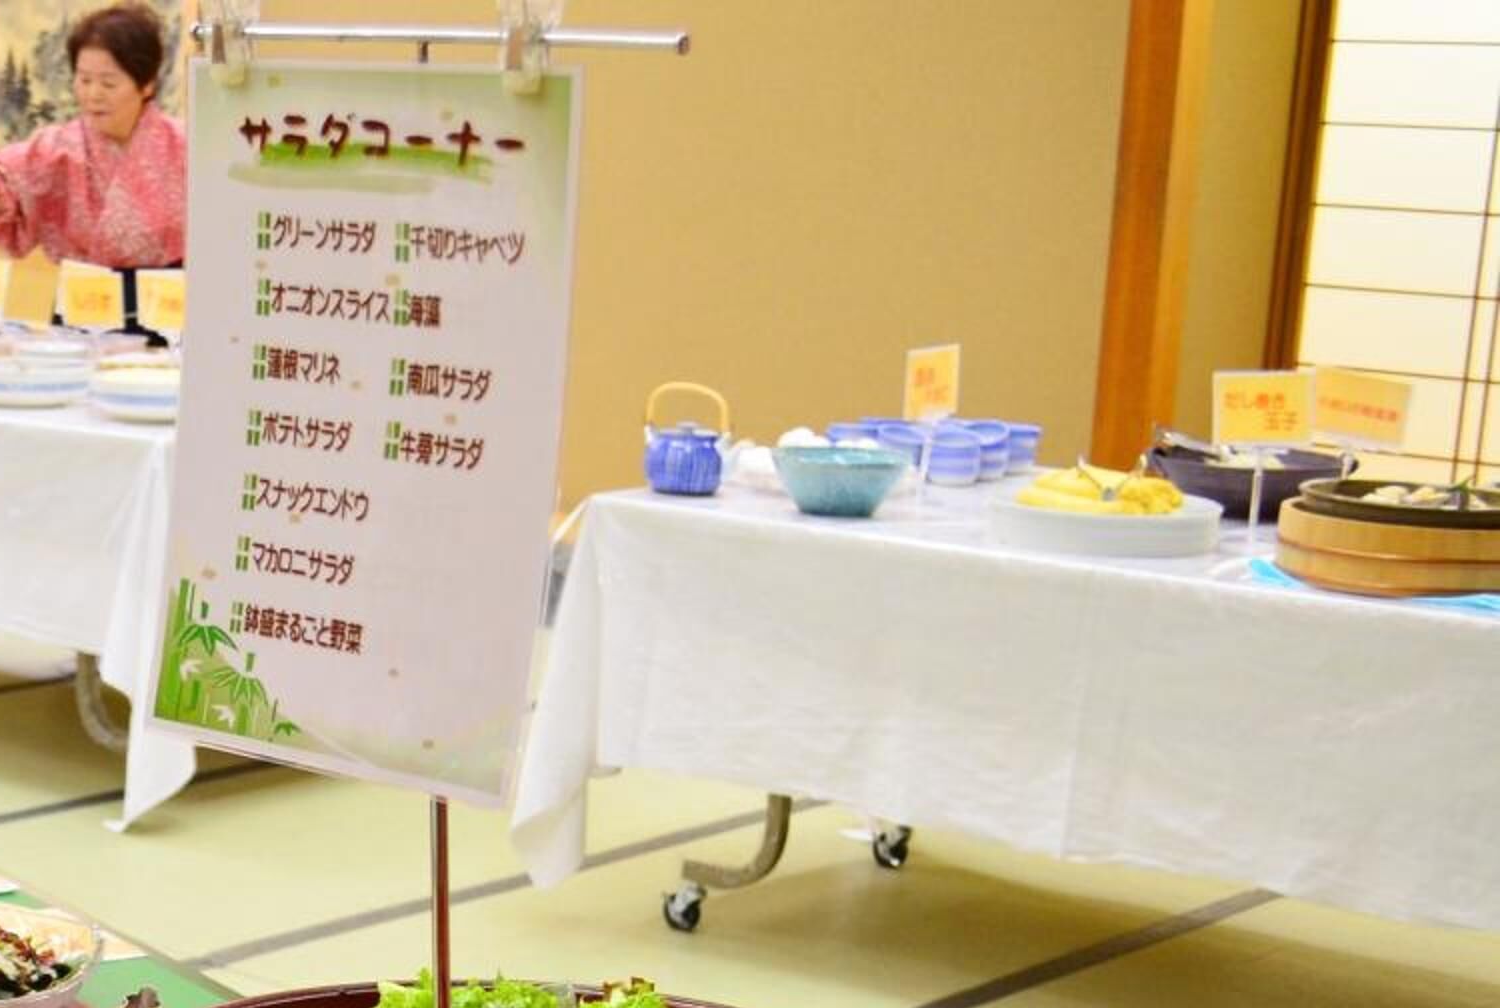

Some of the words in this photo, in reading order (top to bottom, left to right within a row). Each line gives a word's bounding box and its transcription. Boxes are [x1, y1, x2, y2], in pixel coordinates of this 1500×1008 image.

[239, 113, 525, 166] サラダコーナー
[273, 215, 376, 253] グリーンサラダ
[410, 226, 526, 265] 千切りキャベツ
[271, 282, 390, 323] オニオンスライス
[267, 347, 341, 384] 蓮根マリネ
[405, 362, 492, 402] 南瓜サラダ
[256, 478, 370, 521] スナックエンドウ
[251, 542, 355, 585] マカロニサラダ
[244, 603, 363, 654] 鉢盛まるごと野菜
